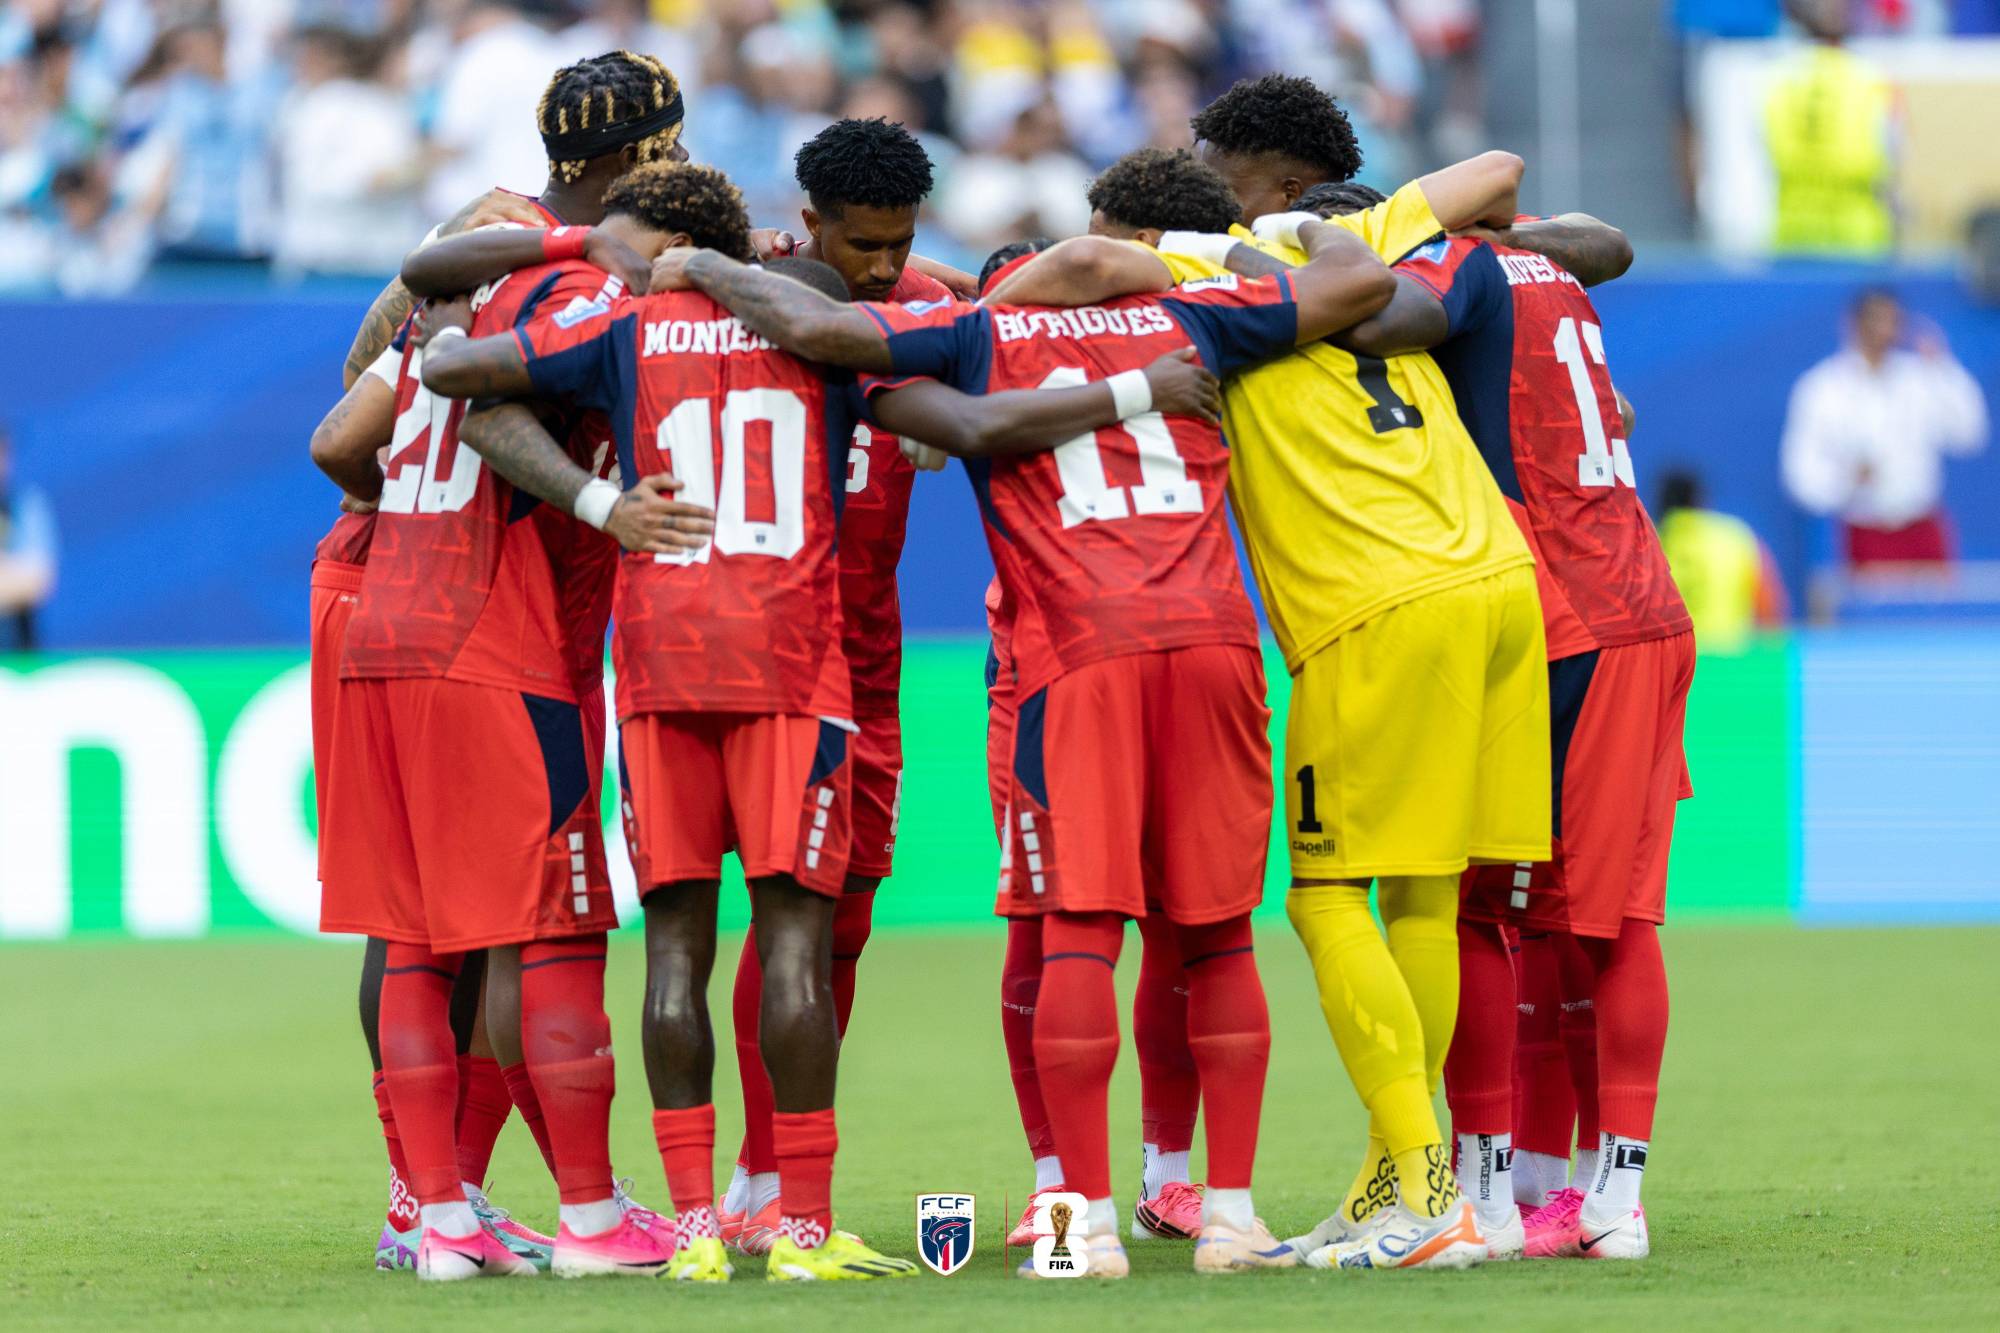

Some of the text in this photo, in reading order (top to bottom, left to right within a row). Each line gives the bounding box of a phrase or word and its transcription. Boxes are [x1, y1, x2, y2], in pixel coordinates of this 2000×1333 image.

[642, 317, 780, 357] MONTE
[378, 346, 482, 513] 20
[1037, 366, 1204, 529] 11
[656, 387, 807, 567] 10
[1296, 765, 1323, 833] 1
[1293, 839, 1336, 855] capelli
[1480, 1150, 1492, 1201] TAPEDESIGN
[1595, 1147, 1614, 1195] TAPEDESIGN
